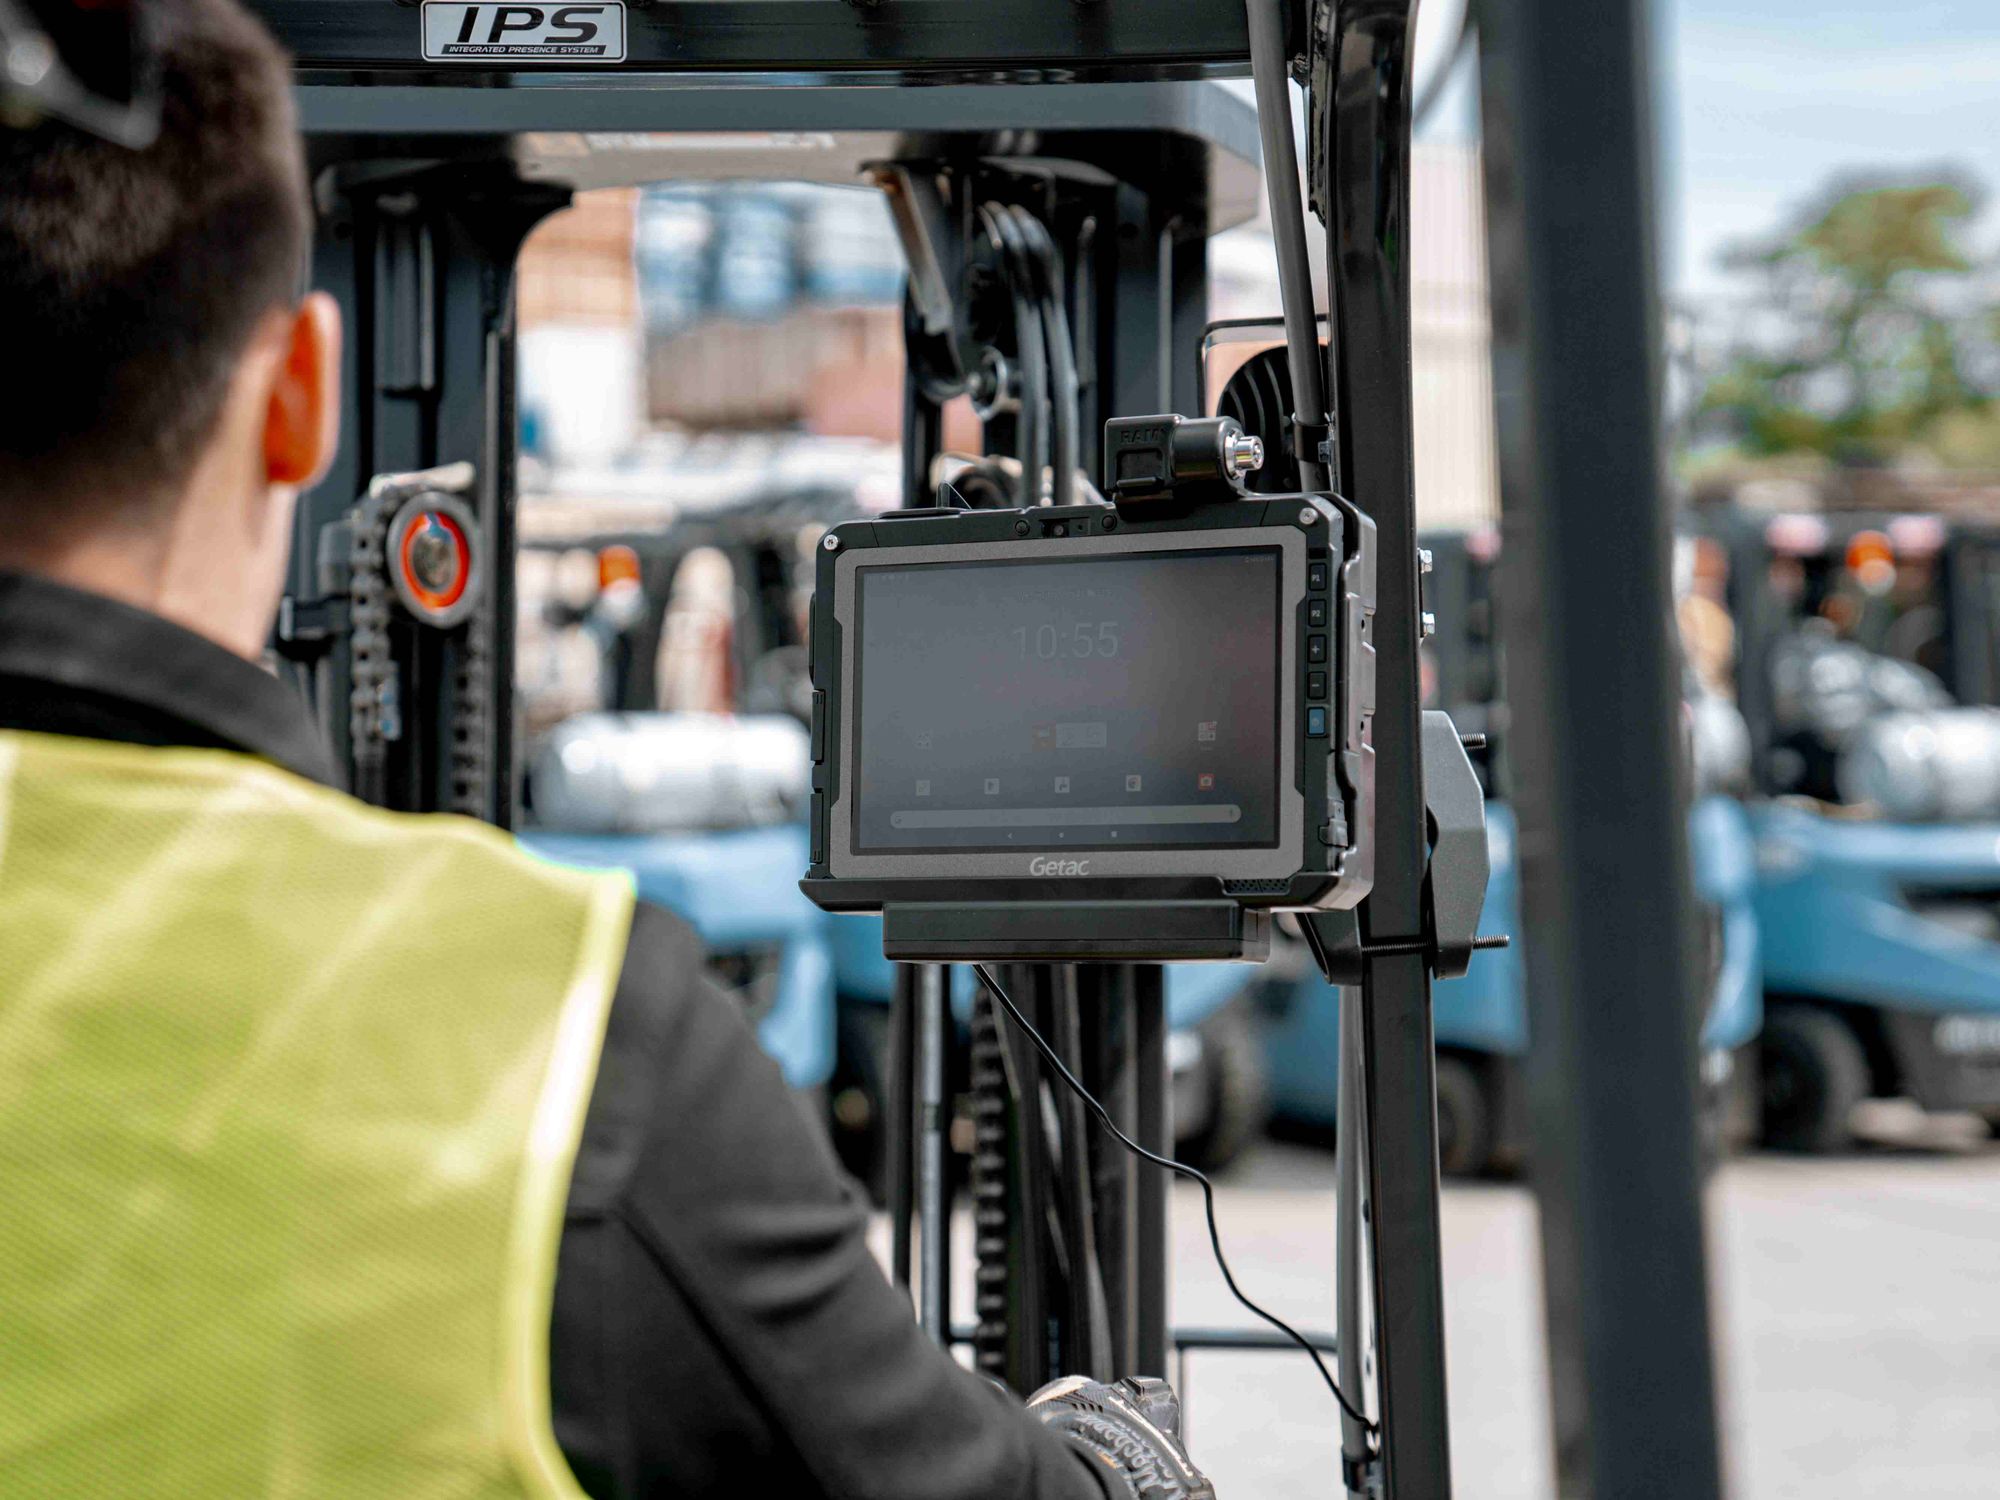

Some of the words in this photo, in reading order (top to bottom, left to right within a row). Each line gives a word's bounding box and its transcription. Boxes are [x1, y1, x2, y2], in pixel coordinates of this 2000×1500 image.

[457, 6, 604, 43] IPS
[449, 45, 505, 53] INTEGRATED
[560, 46, 599, 54] SYSTEM
[1311, 574, 1320, 582] P1
[1311, 609, 1321, 617] P2
[1013, 621, 1119, 660] 10:55
[1030, 856, 1090, 877] Getac
